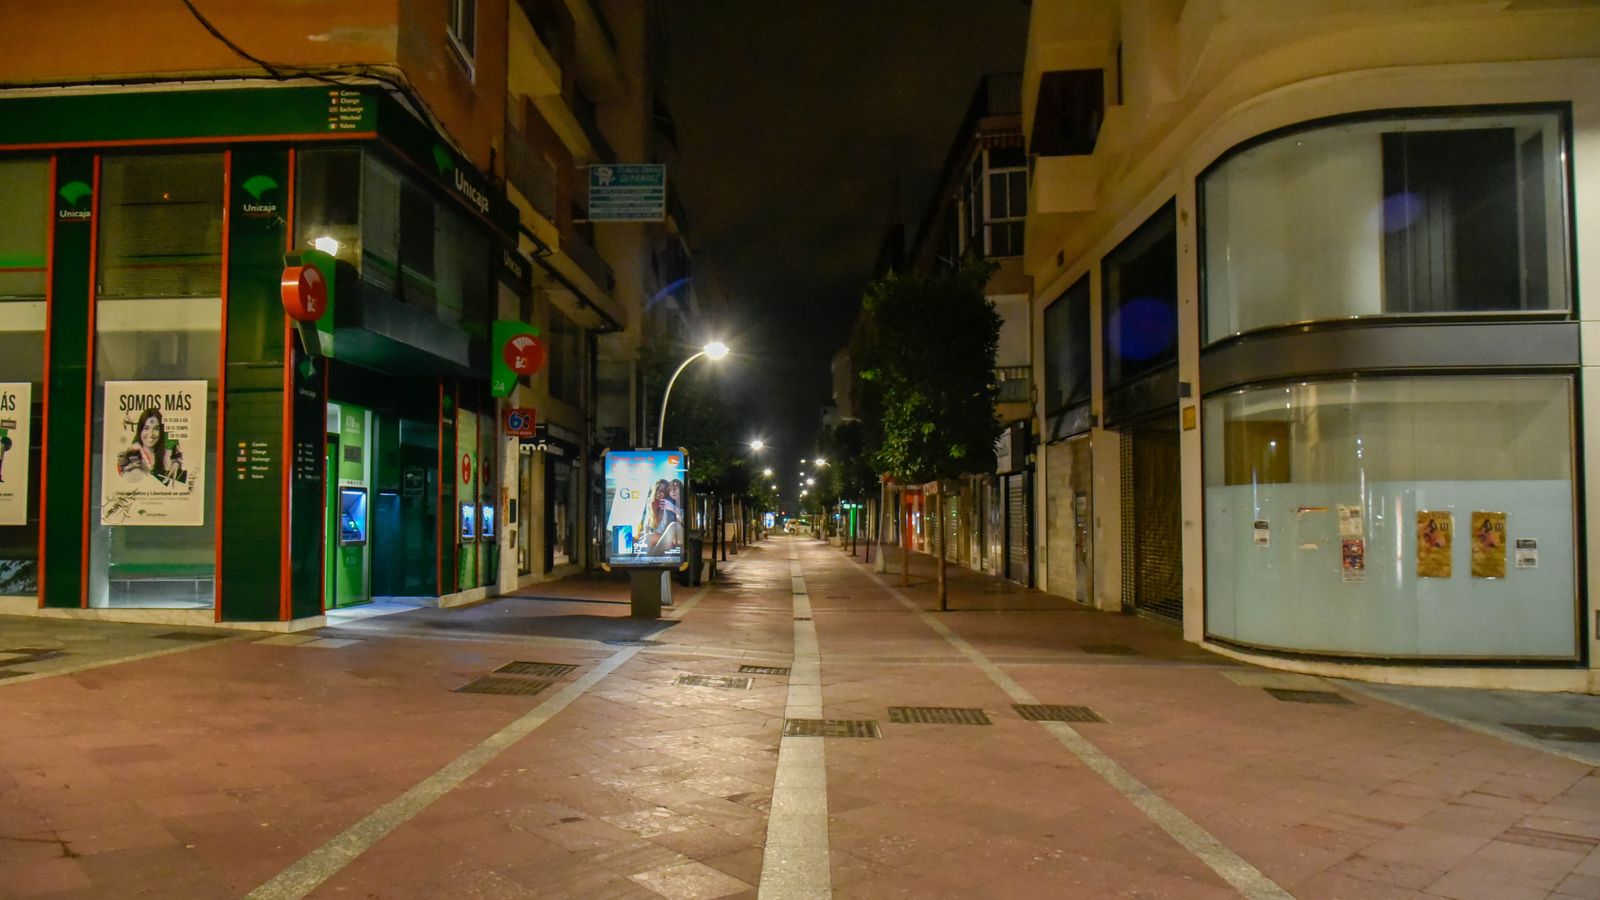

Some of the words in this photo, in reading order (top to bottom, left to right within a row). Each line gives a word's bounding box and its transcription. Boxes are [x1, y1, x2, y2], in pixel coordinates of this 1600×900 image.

[455, 167, 490, 214] Unicaja
[59, 209, 91, 219] Unicaja
[243, 203, 276, 213] Unicaja
[119, 394, 162, 411] SOMOS
[165, 391, 192, 411] MÁS
